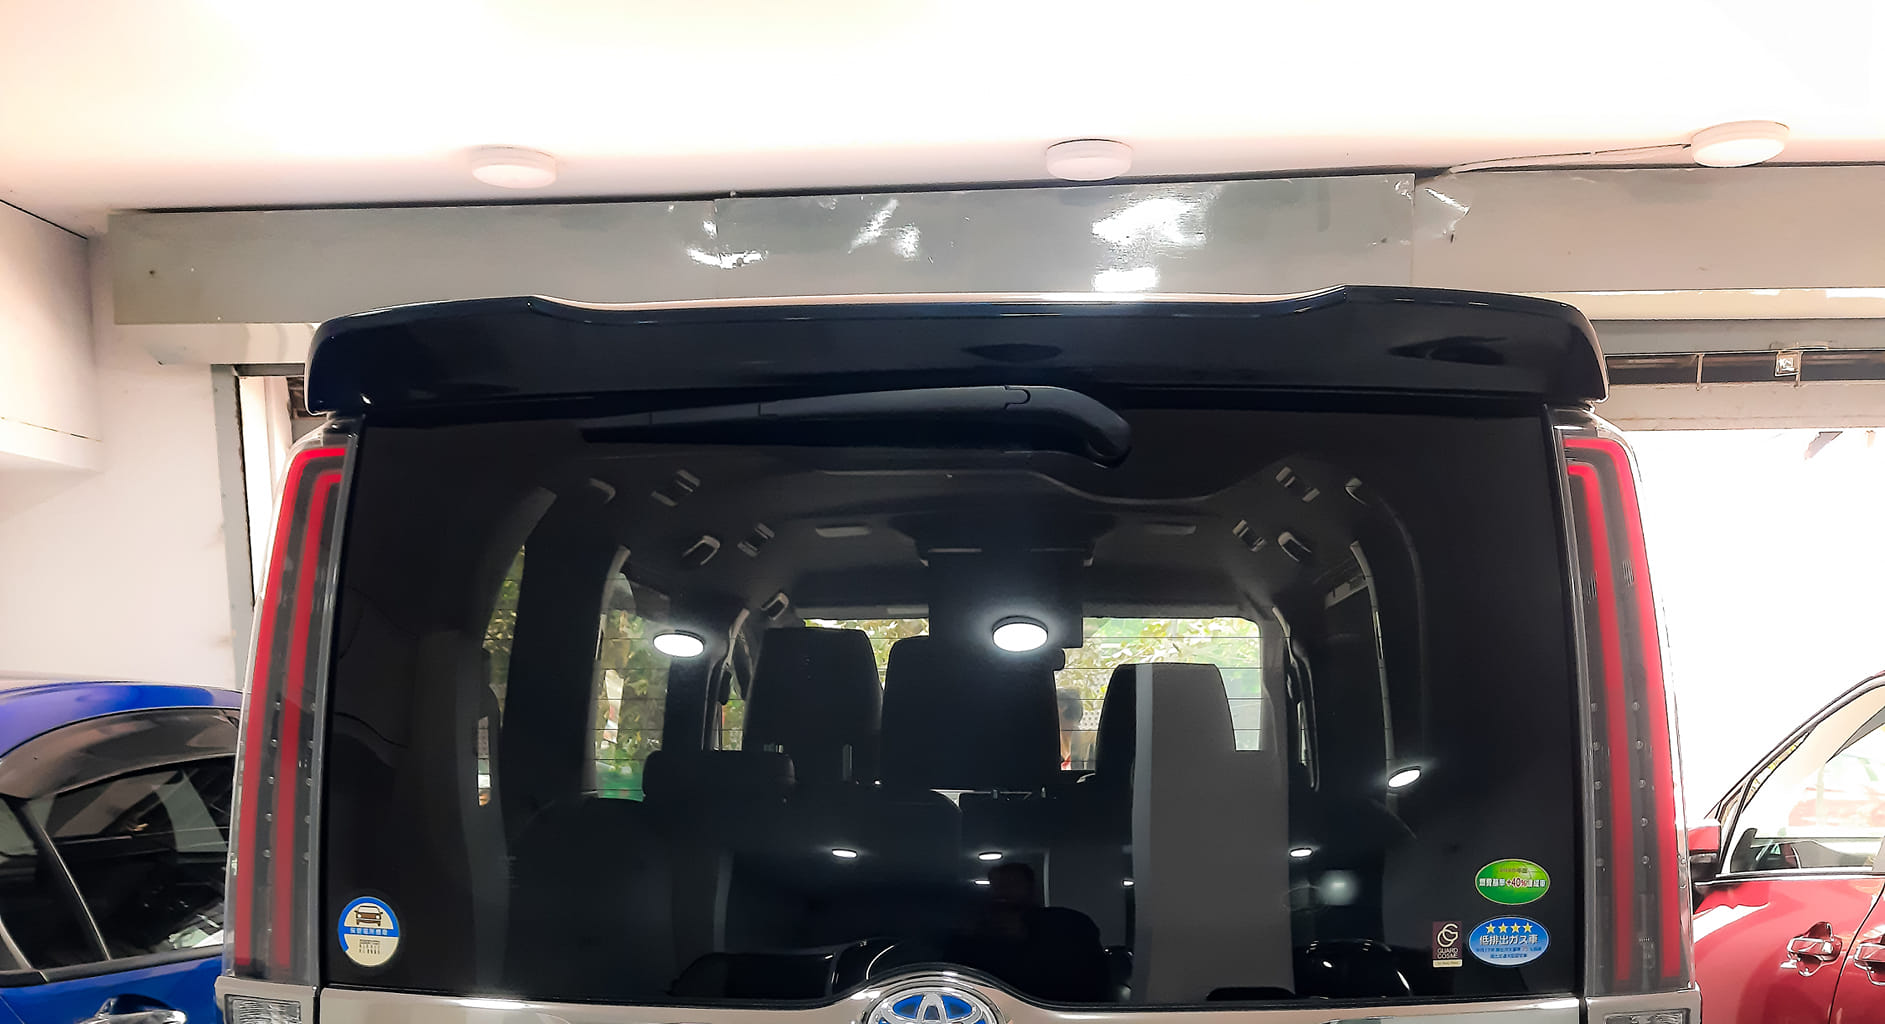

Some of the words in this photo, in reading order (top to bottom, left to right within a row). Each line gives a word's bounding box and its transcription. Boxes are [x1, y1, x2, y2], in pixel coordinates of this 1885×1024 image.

[1479, 934, 1539, 946] 低排出ガス車
